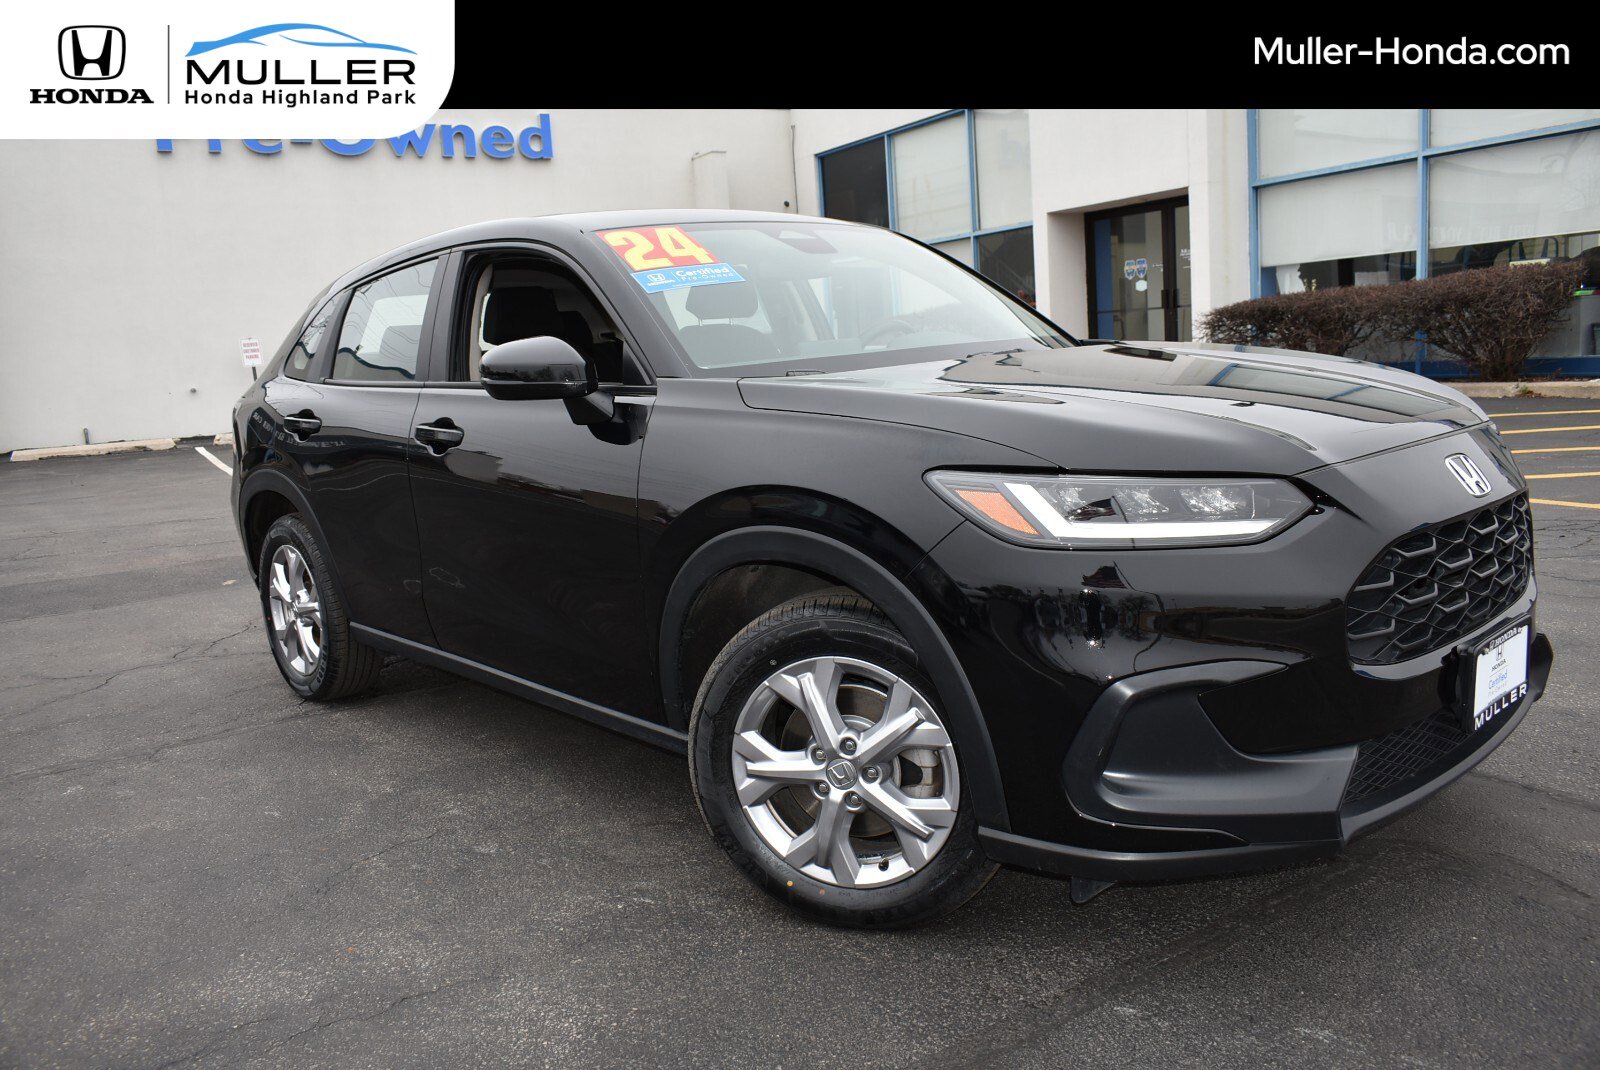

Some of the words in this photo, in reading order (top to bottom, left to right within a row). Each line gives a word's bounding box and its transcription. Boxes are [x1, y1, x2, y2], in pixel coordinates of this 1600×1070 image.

[603, 227, 715, 272] 24
[675, 266, 730, 277] Certified
[1474, 683, 1528, 731] MULLER
